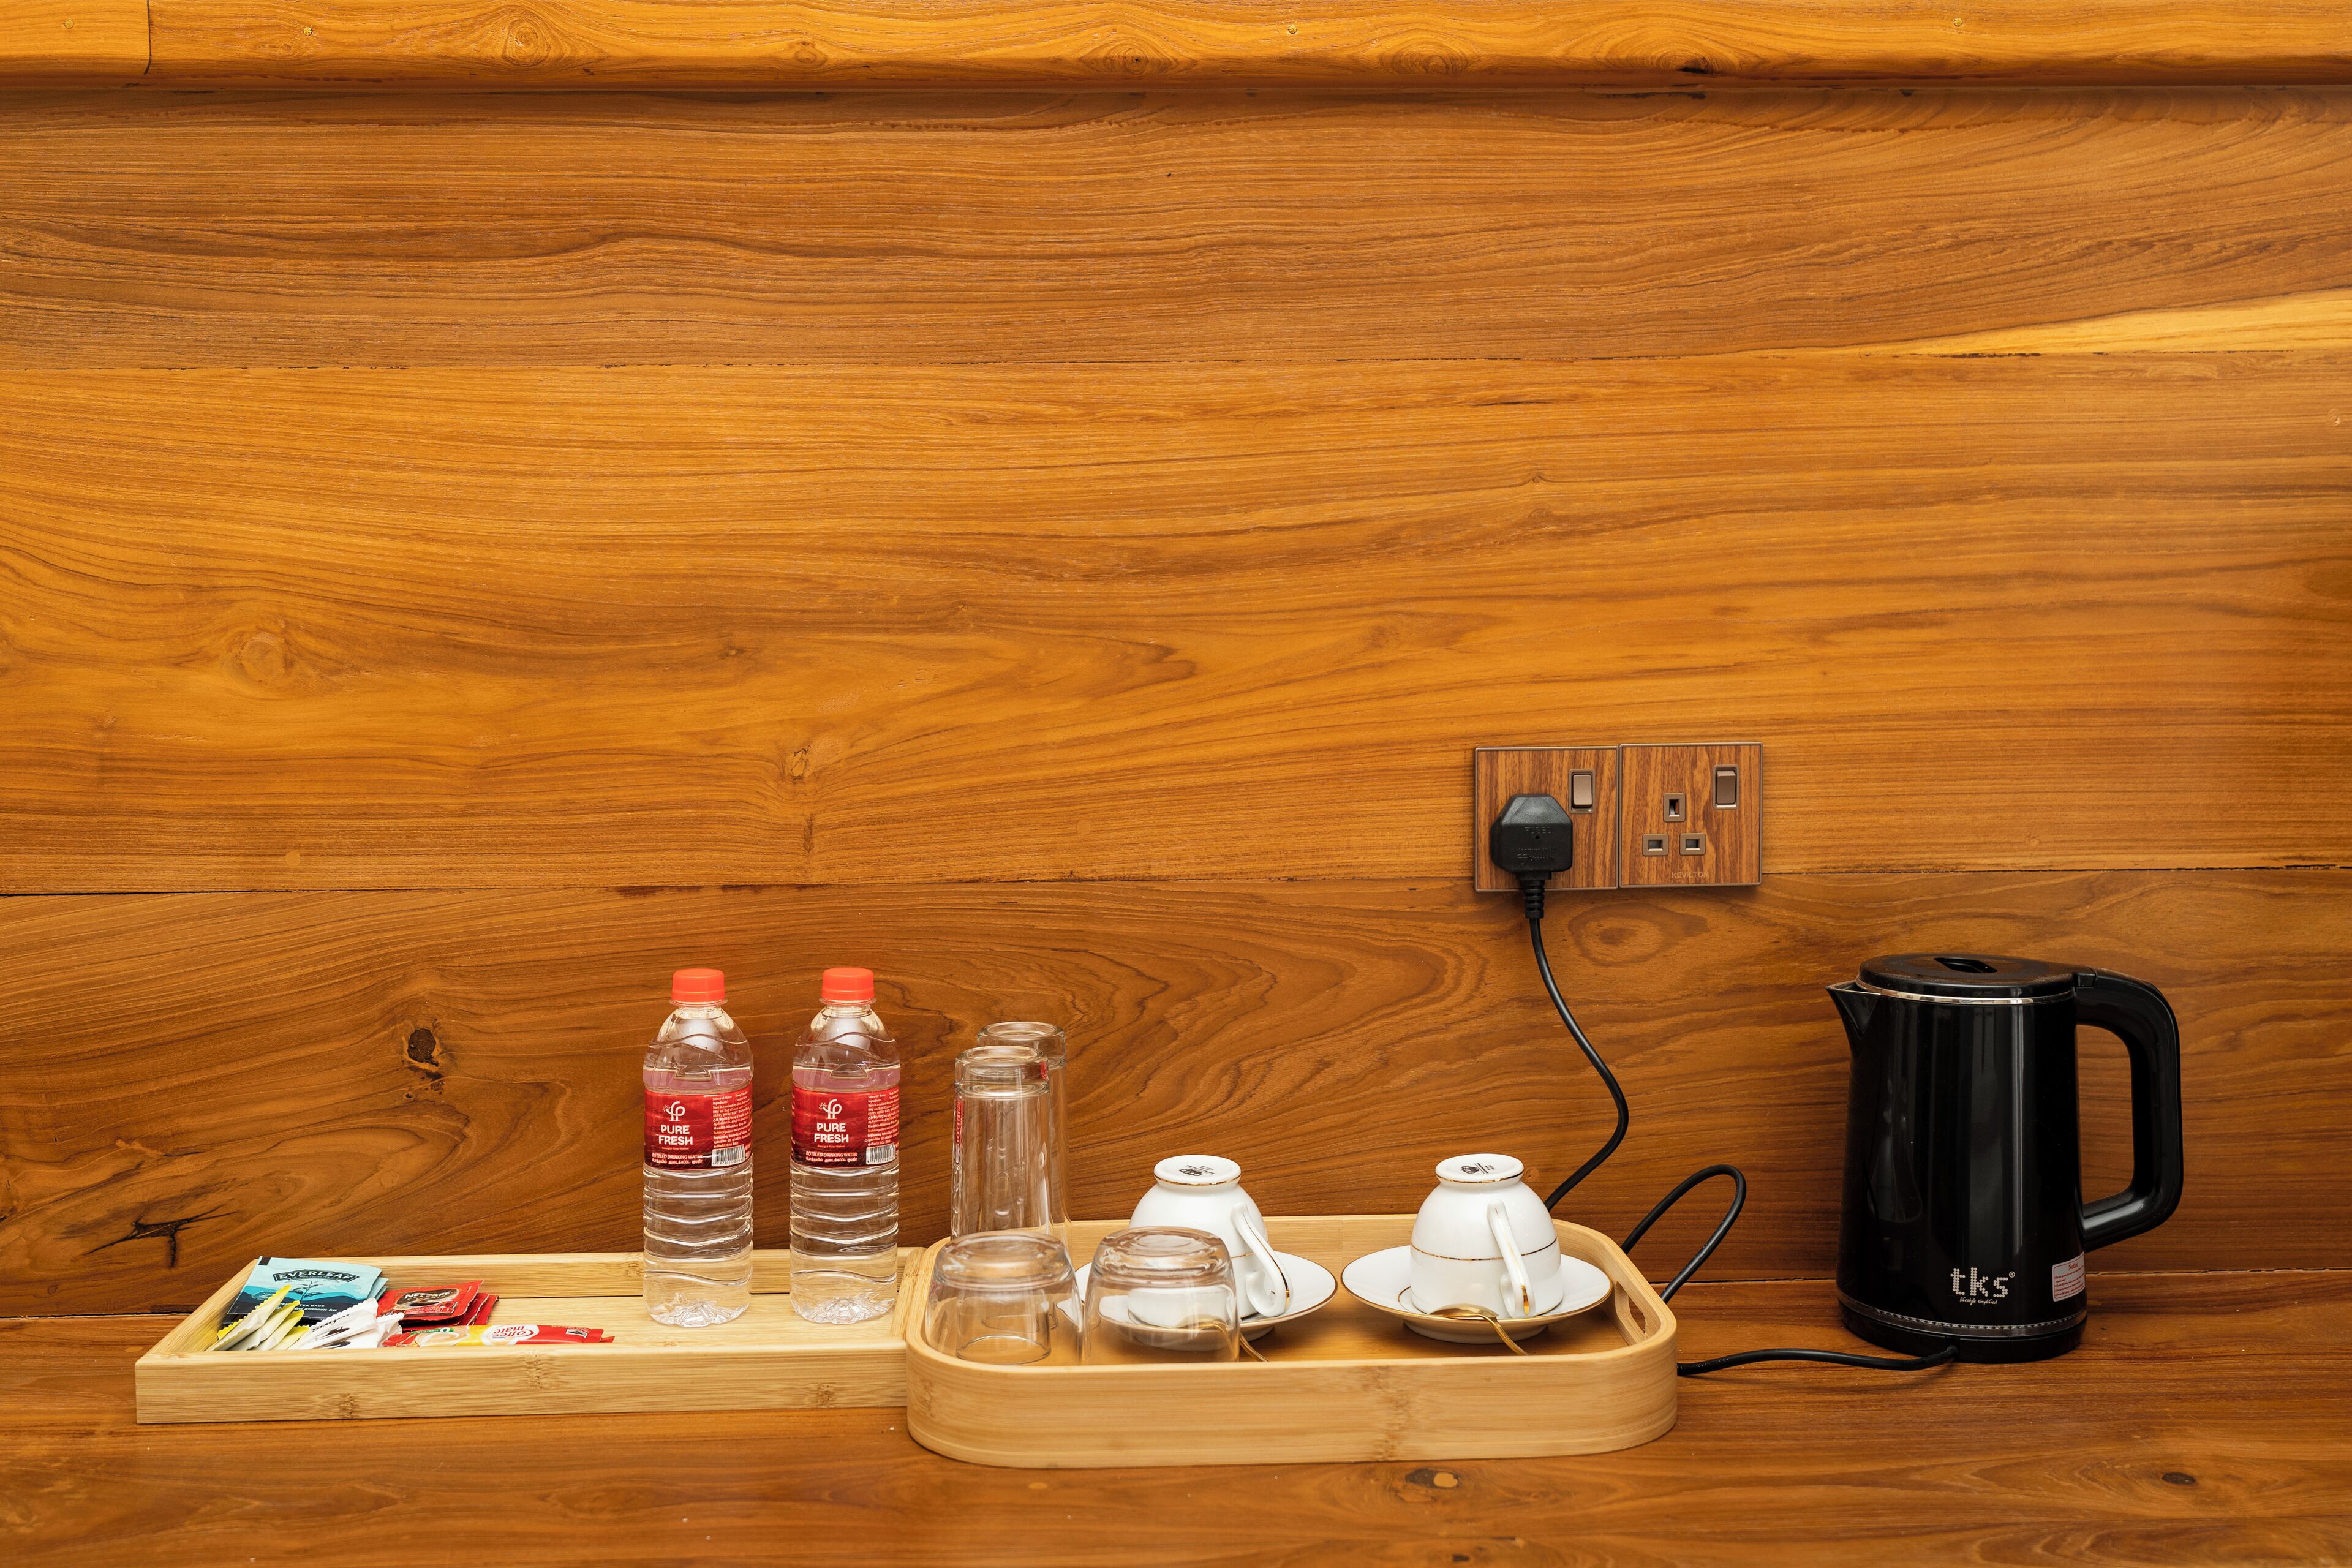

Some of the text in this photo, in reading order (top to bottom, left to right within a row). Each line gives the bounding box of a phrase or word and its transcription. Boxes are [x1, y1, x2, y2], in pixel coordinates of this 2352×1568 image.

[660, 1125, 690, 1134] PURE
[817, 1122, 846, 1132] PURE
[658, 1135, 693, 1145] FRESH
[814, 1133, 849, 1143] FRESH
[278, 1271, 353, 1280] EVERLEAF
[1950, 1267, 2008, 1298] tks
